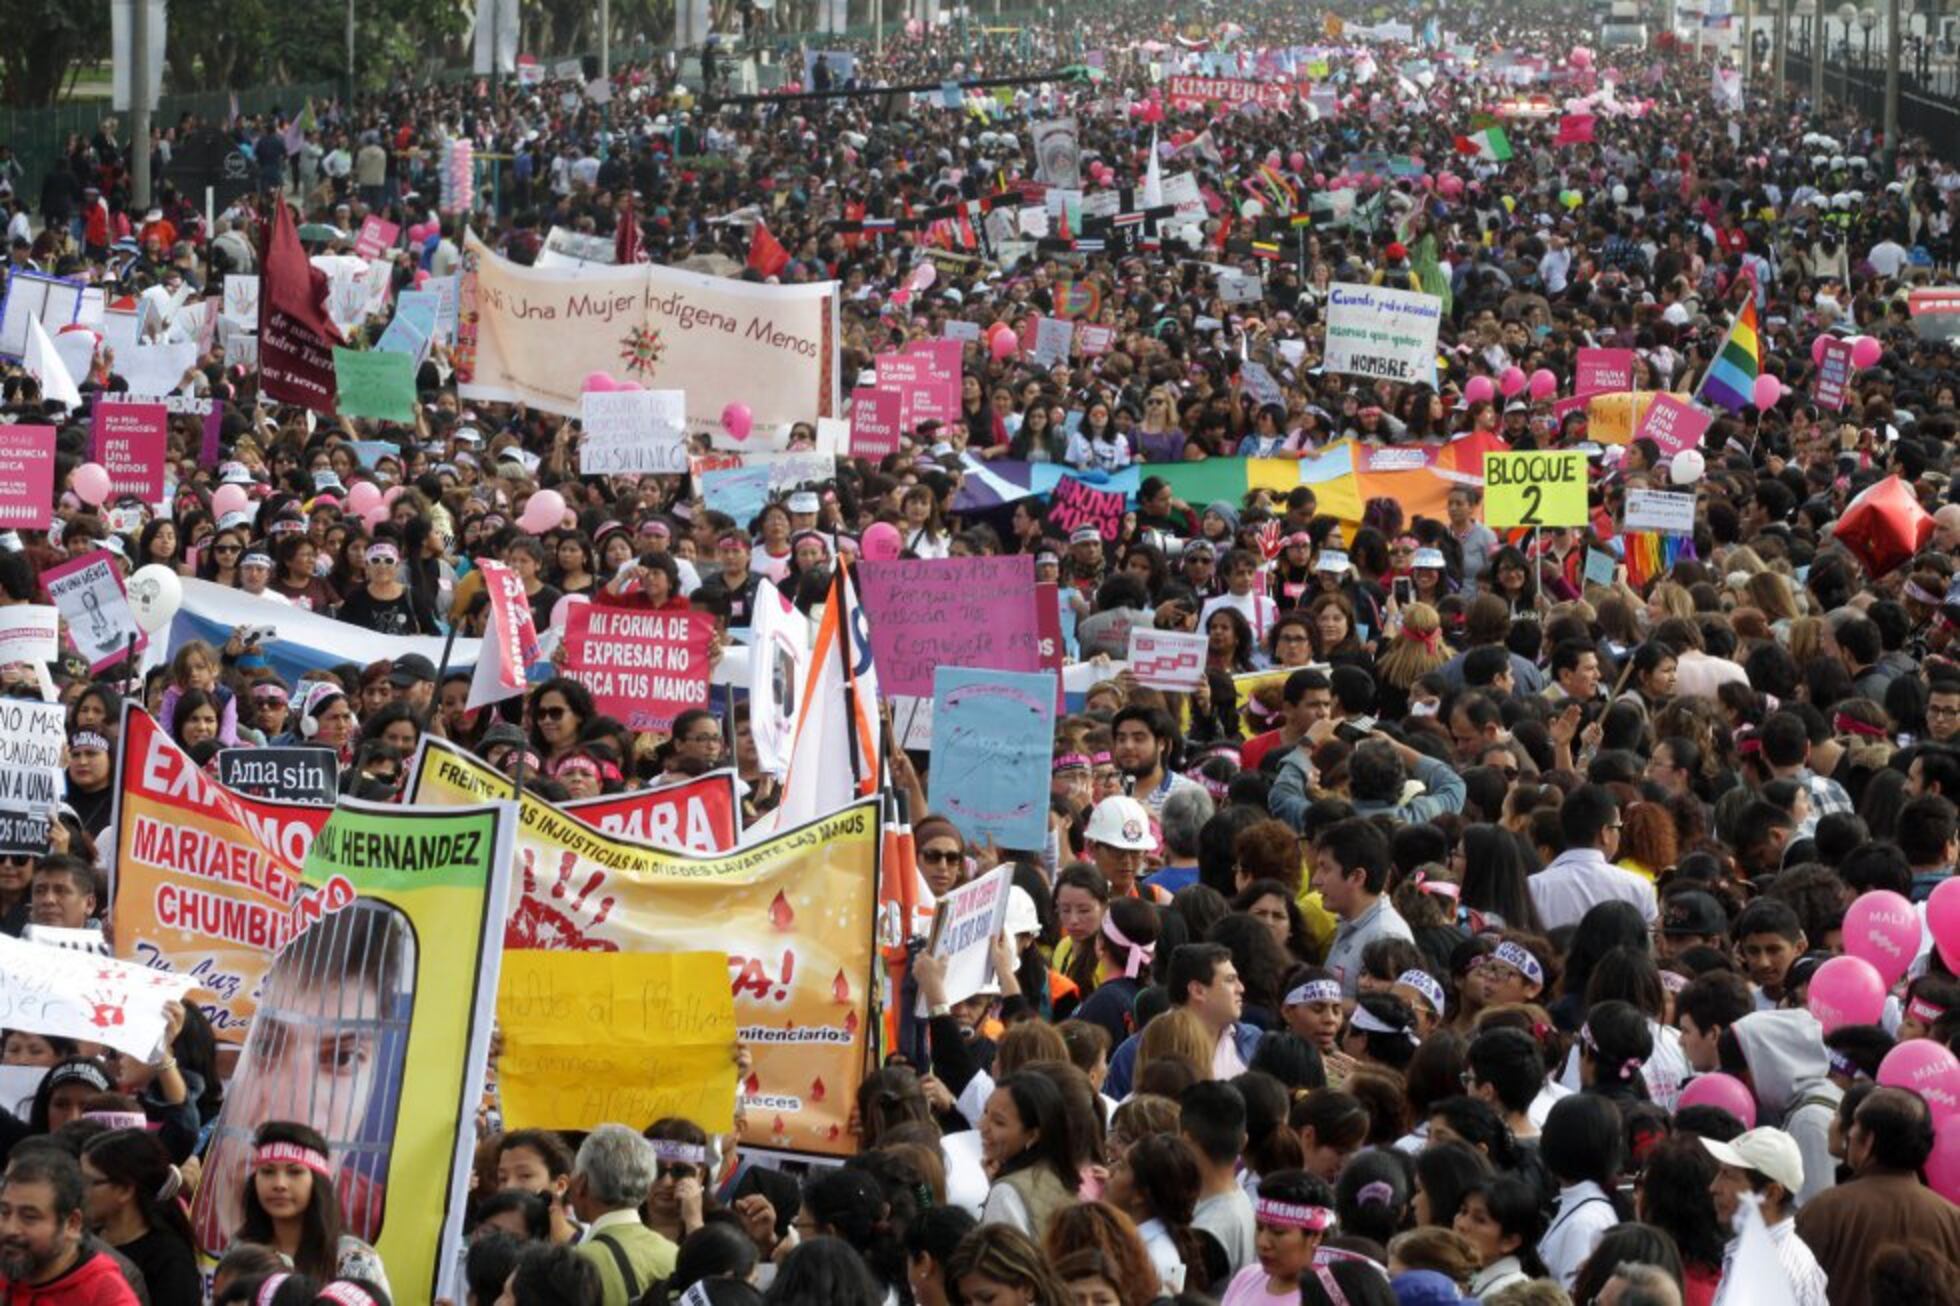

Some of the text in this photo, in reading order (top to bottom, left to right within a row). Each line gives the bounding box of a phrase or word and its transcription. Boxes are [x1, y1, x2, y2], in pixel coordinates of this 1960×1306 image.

[1331, 289, 1376, 306] Cuando
[485, 287, 818, 359] Ni Una Mujer Indígena Menos
[855, 423, 891, 434] Menos
[0, 449, 48, 459] OLENCIA
[105, 450, 132, 463] Una
[105, 461, 149, 474] Menos
[1487, 456, 1577, 486] BLOQUE
[1519, 485, 1544, 526] 2
[588, 613, 689, 641] MI FORMA DE
[583, 640, 689, 672] EXPRESAR NO
[617, 673, 649, 699] TUS
[652, 676, 706, 703] MANOS
[13, 772, 23, 799] A
[228, 758, 325, 790] Ama sin
[439, 761, 495, 797] FRENTE
[537, 815, 630, 871] INJUSTICIAS
[713, 843, 780, 876] LAVARTE
[786, 832, 817, 850] LAS
[600, 794, 720, 852] PARA
[130, 814, 299, 905] MARIAELEN
[340, 829, 482, 872] HERNANDEZ
[157, 882, 283, 952] CHUMBI
[737, 1026, 852, 1043] nitenciarios
[1266, 1200, 1314, 1221] MENOS
